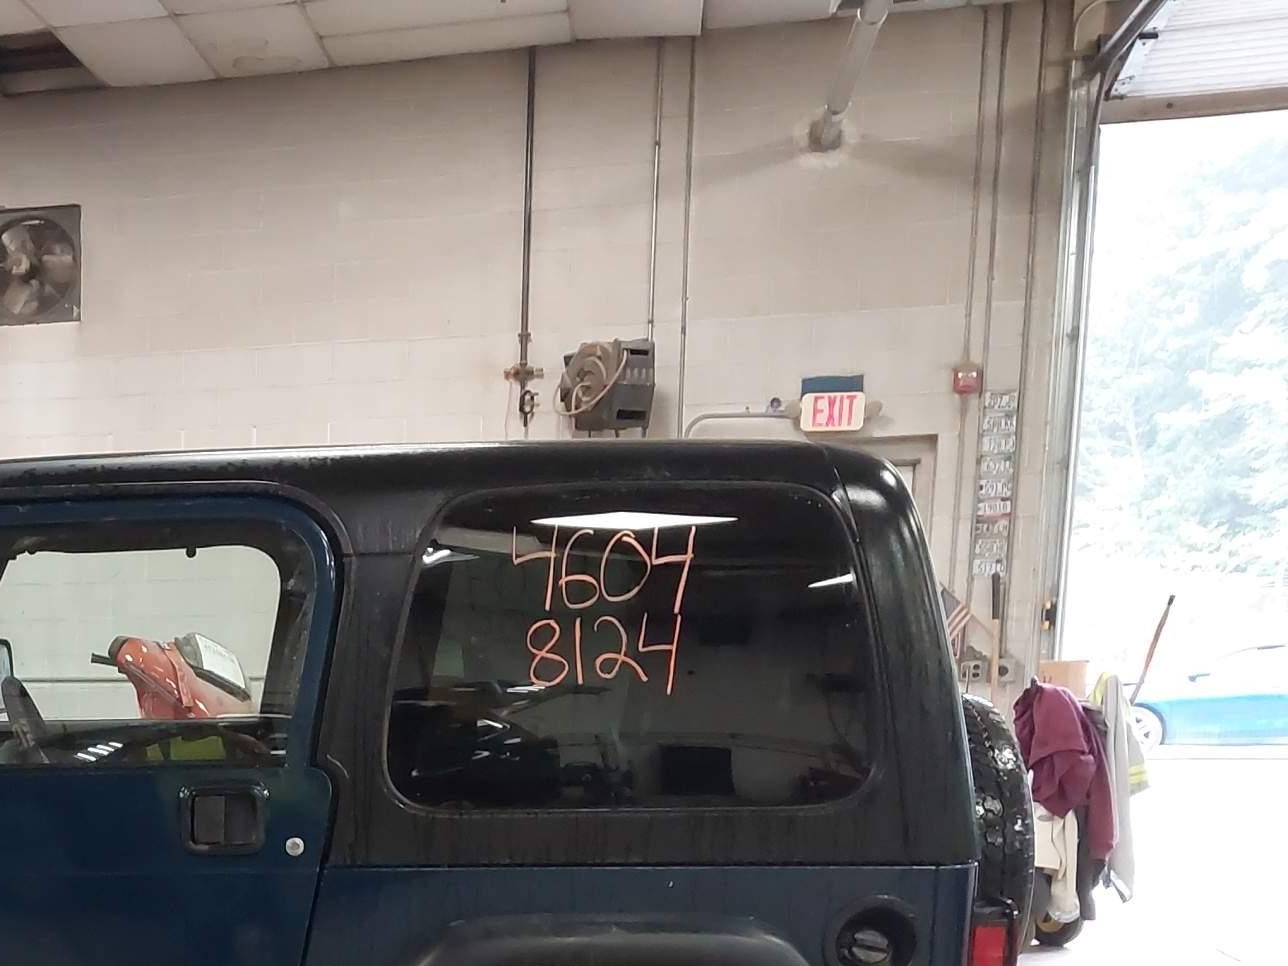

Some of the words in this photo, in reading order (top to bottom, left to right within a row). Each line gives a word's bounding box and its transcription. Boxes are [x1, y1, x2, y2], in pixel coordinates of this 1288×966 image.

[812, 395, 857, 427] EXIT
[512, 524, 696, 614] 4604
[526, 611, 681, 696] 8124
